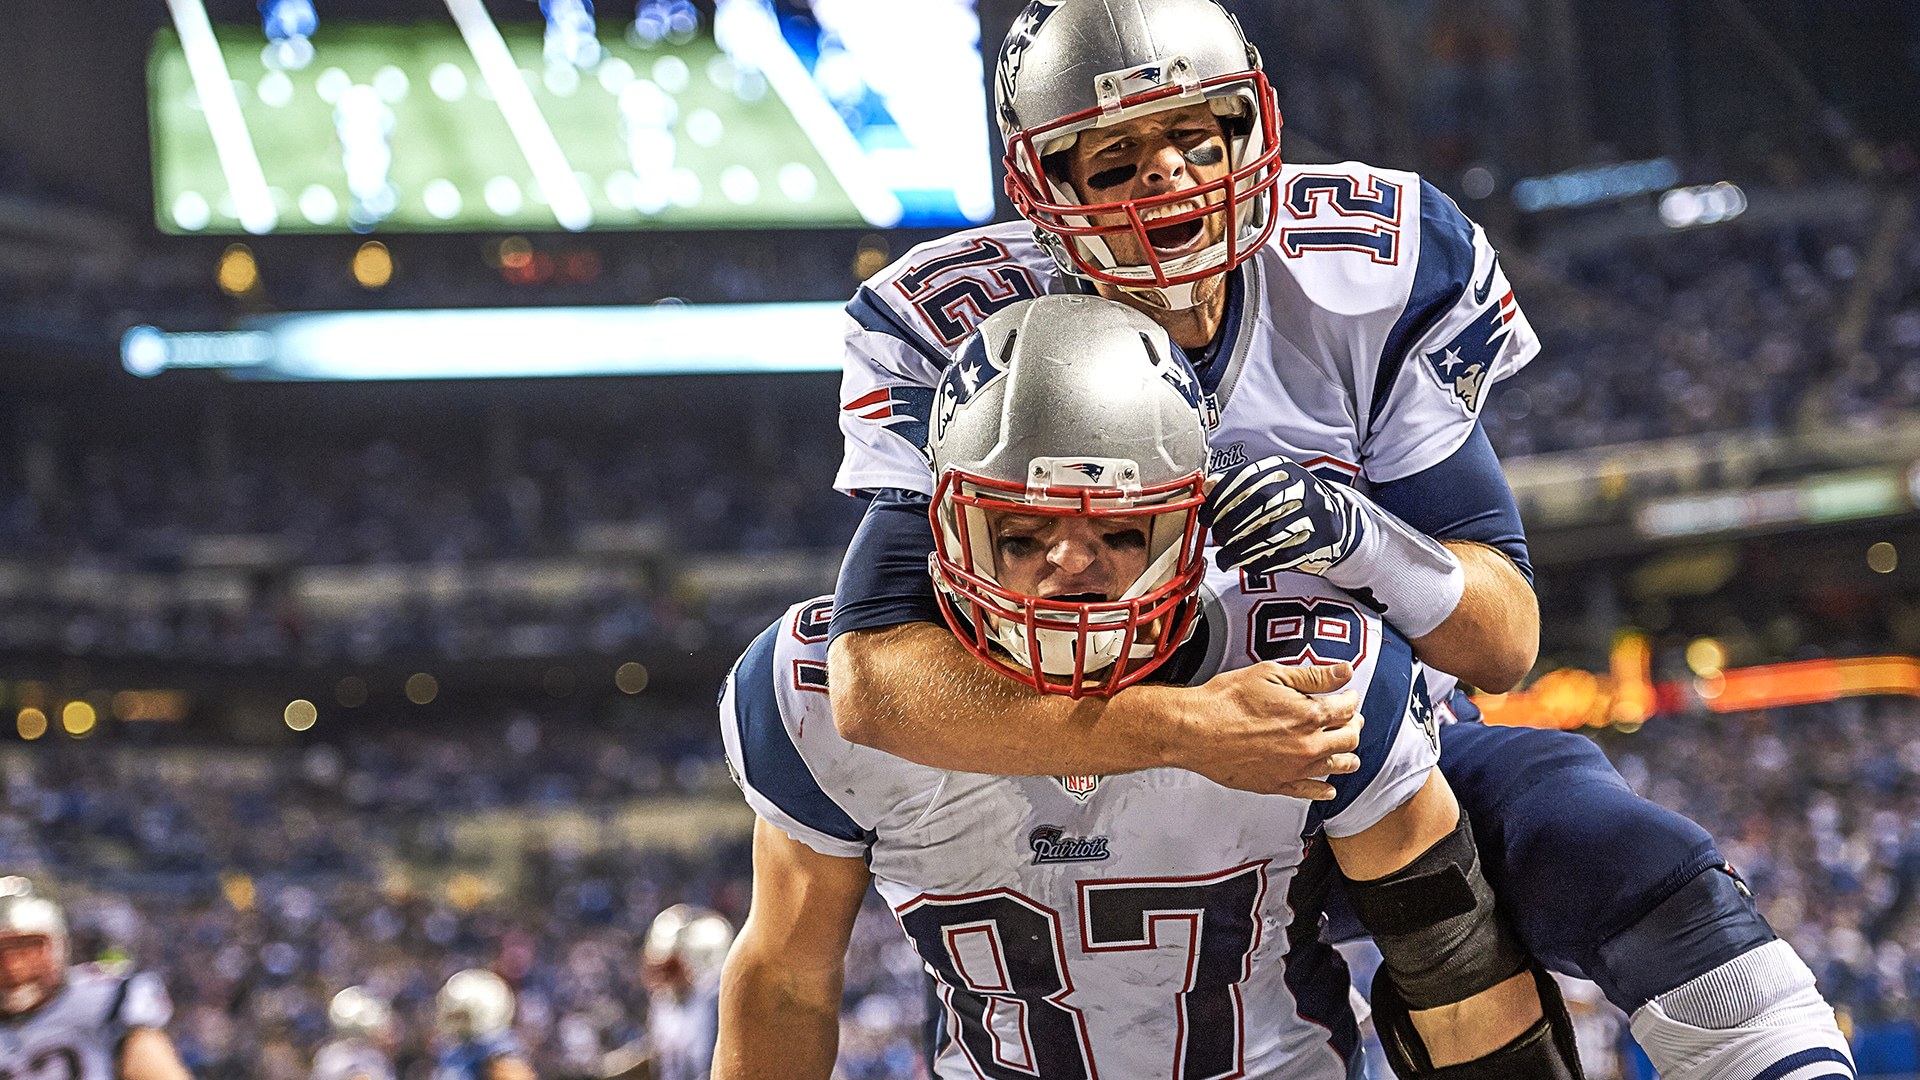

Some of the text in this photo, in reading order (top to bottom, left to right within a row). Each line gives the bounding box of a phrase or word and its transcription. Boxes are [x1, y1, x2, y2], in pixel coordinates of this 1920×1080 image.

[1280, 173, 1402, 266] 12
[893, 237, 1041, 347] 12
[1211, 442, 1249, 472] riots
[1069, 776, 1094, 791] NFL
[1030, 837, 1110, 866] Patriots
[896, 859, 1273, 1080] 87
